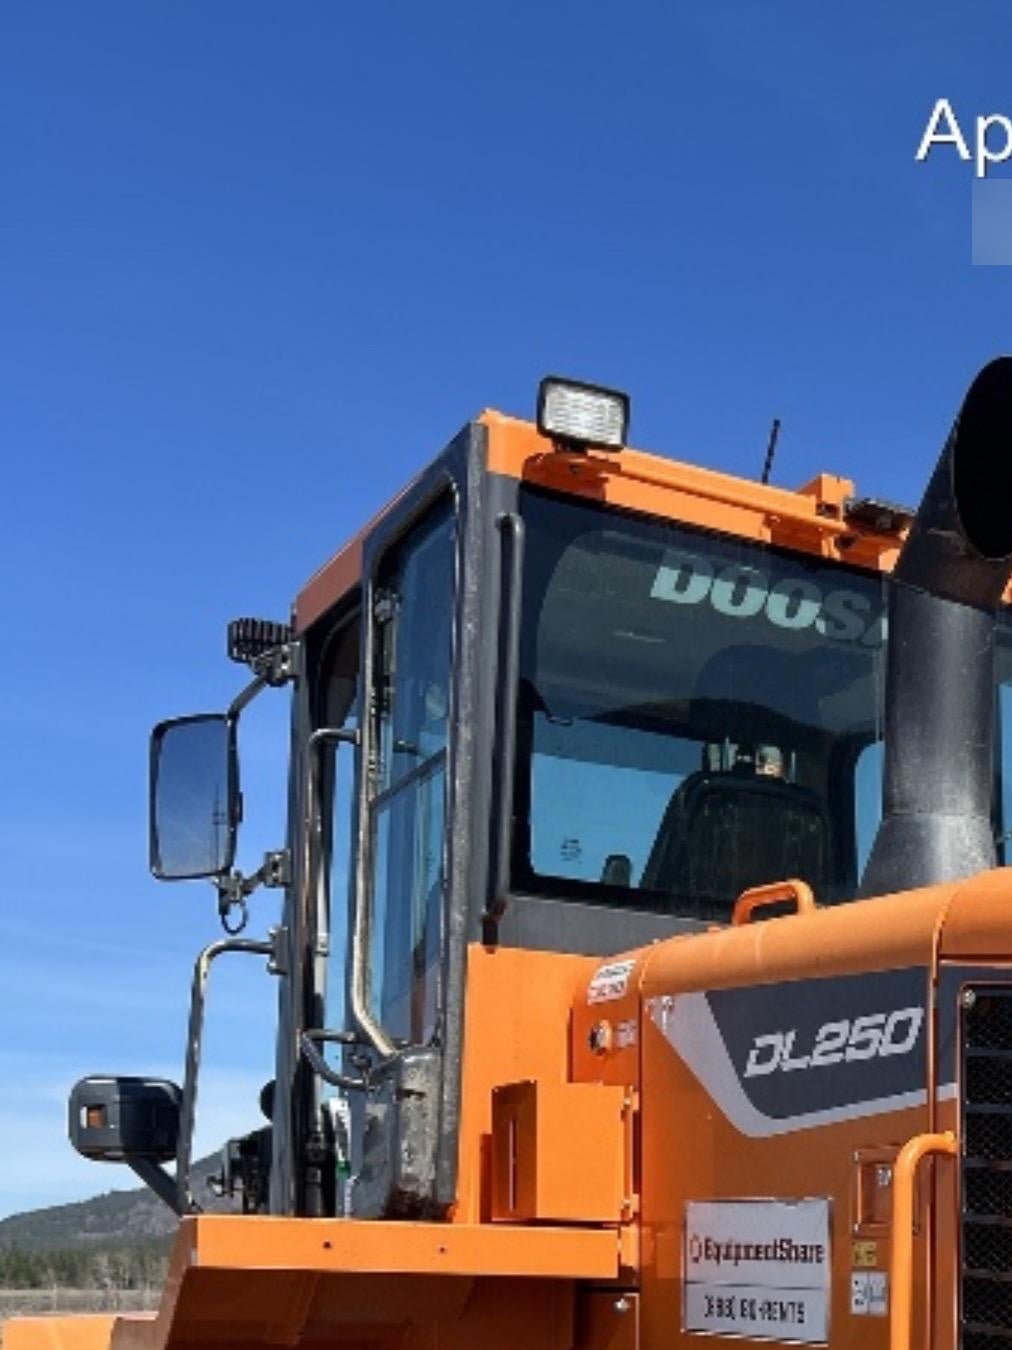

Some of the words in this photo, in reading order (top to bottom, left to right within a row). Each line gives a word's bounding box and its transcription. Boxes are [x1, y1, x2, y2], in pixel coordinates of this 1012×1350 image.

[650, 550, 889, 648] DOOS
[743, 1005, 924, 1078] DL250
[704, 1237, 825, 1266] EquipmentShare
